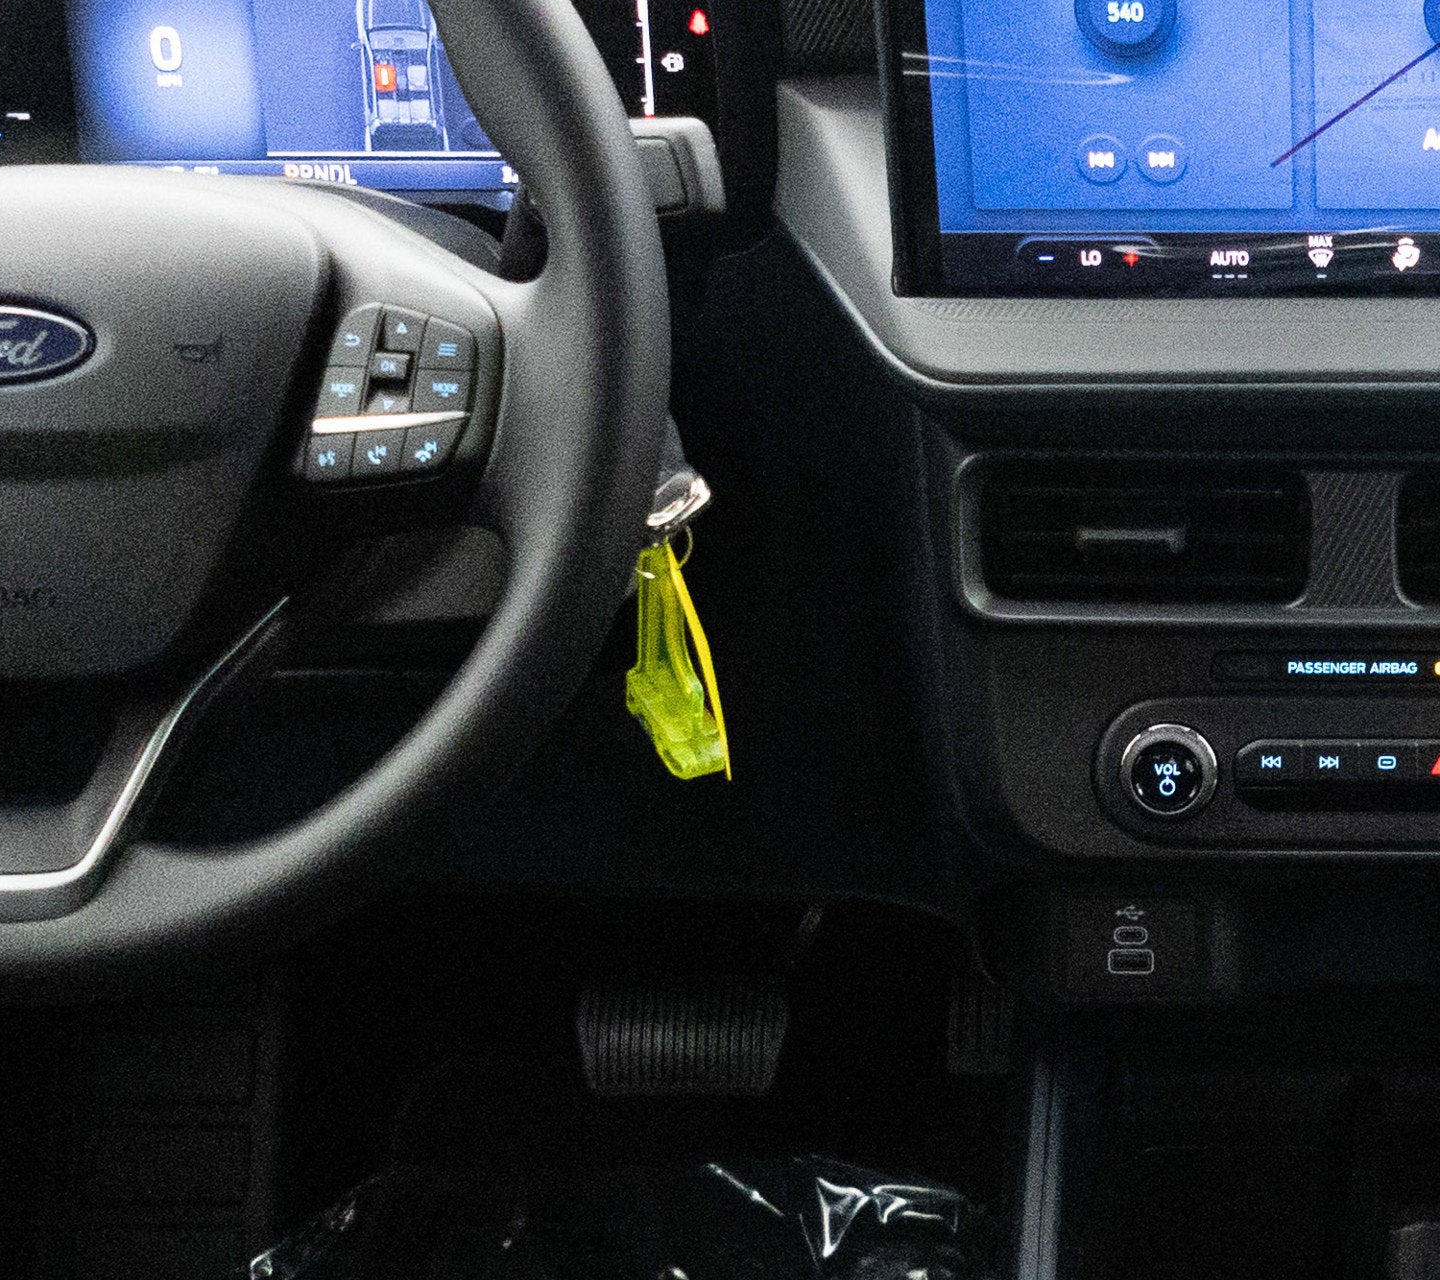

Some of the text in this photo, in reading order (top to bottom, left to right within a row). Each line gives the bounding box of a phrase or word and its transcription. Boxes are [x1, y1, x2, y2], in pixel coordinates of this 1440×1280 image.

[1106, 2, 1145, 23] 540
[1308, 235, 1334, 250] MAX
[1079, 249, 1102, 267] LO
[1209, 249, 1250, 267] AUTO
[1287, 661, 1366, 674] PASSENGER
[1369, 661, 1418, 674] AIRBAG
[1154, 763, 1181, 776] VOL
